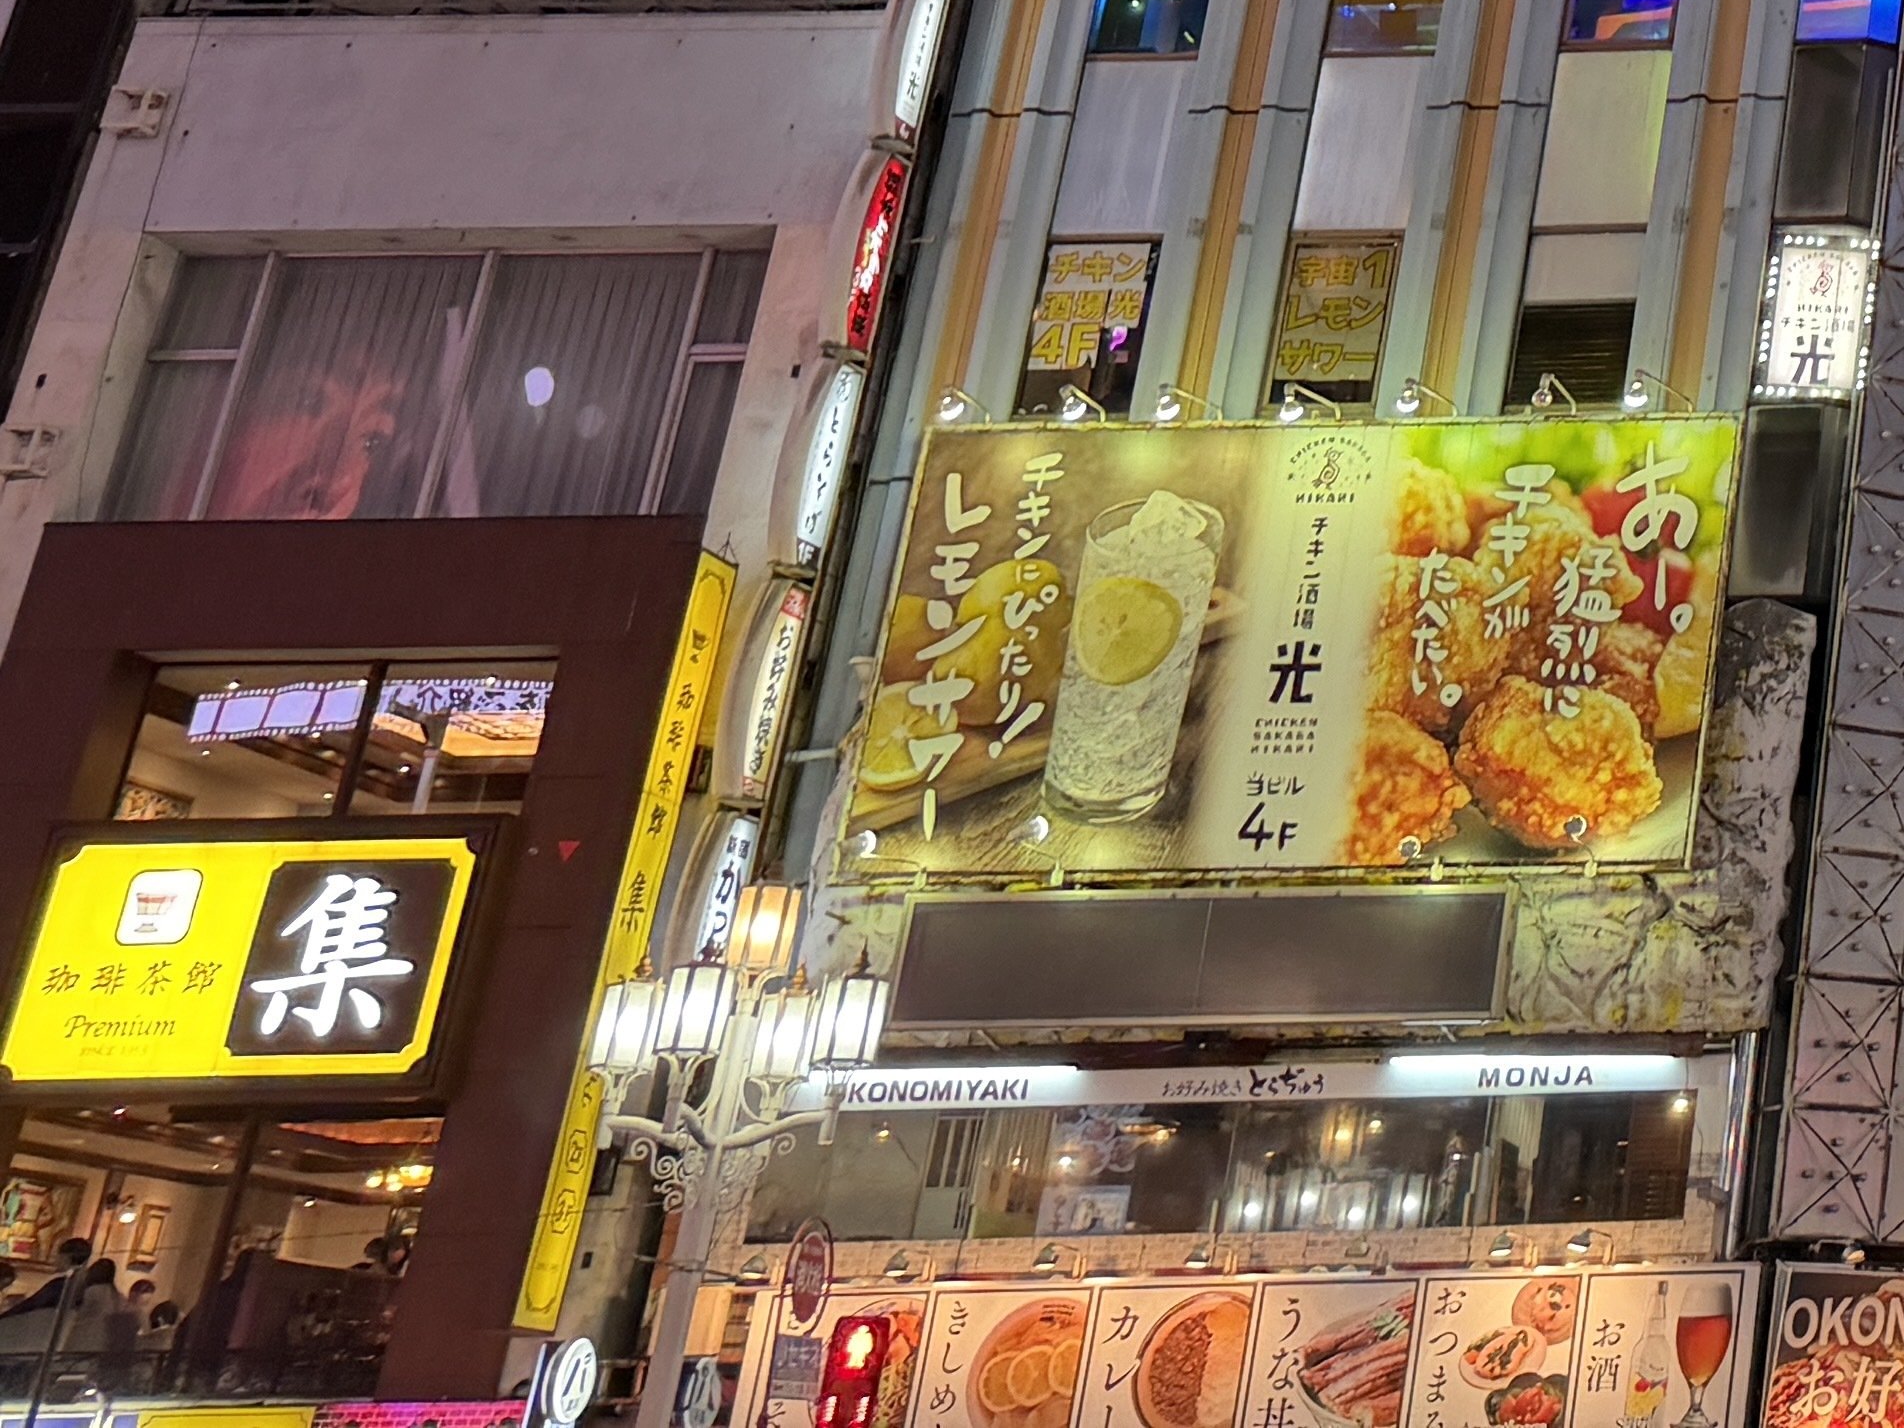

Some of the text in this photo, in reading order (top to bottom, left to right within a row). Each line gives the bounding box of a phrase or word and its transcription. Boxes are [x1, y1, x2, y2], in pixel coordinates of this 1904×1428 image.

[1050, 251, 1146, 284] チキン
[1285, 296, 1384, 331] レモン
[1031, 324, 1100, 368] 4F
[1277, 340, 1376, 376] サワー
[1790, 334, 1836, 384] 光
[1483, 463, 1558, 640] チキンが
[1614, 441, 1696, 635] あー。
[1293, 517, 1327, 629] チキン酒場
[1409, 548, 1463, 710] たべたい。
[1542, 547, 1624, 719] 猛烈に
[905, 473, 993, 842] レモンサワー
[1268, 641, 1322, 704] 光
[1247, 772, 1305, 797] 当ビル
[1237, 802, 1298, 852] 4F
[698, 868, 738, 950] かっ
[42, 960, 224, 997] 珈琲茶館
[252, 874, 415, 1038] 集
[64, 1015, 176, 1040] Premium
[837, 1079, 1029, 1105] KONOMIYAKI
[1162, 1078, 1243, 1098] お好み焼き
[1477, 1066, 1595, 1089] MONJA
[1255, 1297, 1302, 1428] うな丼
[1587, 1319, 1625, 1392] お酒
